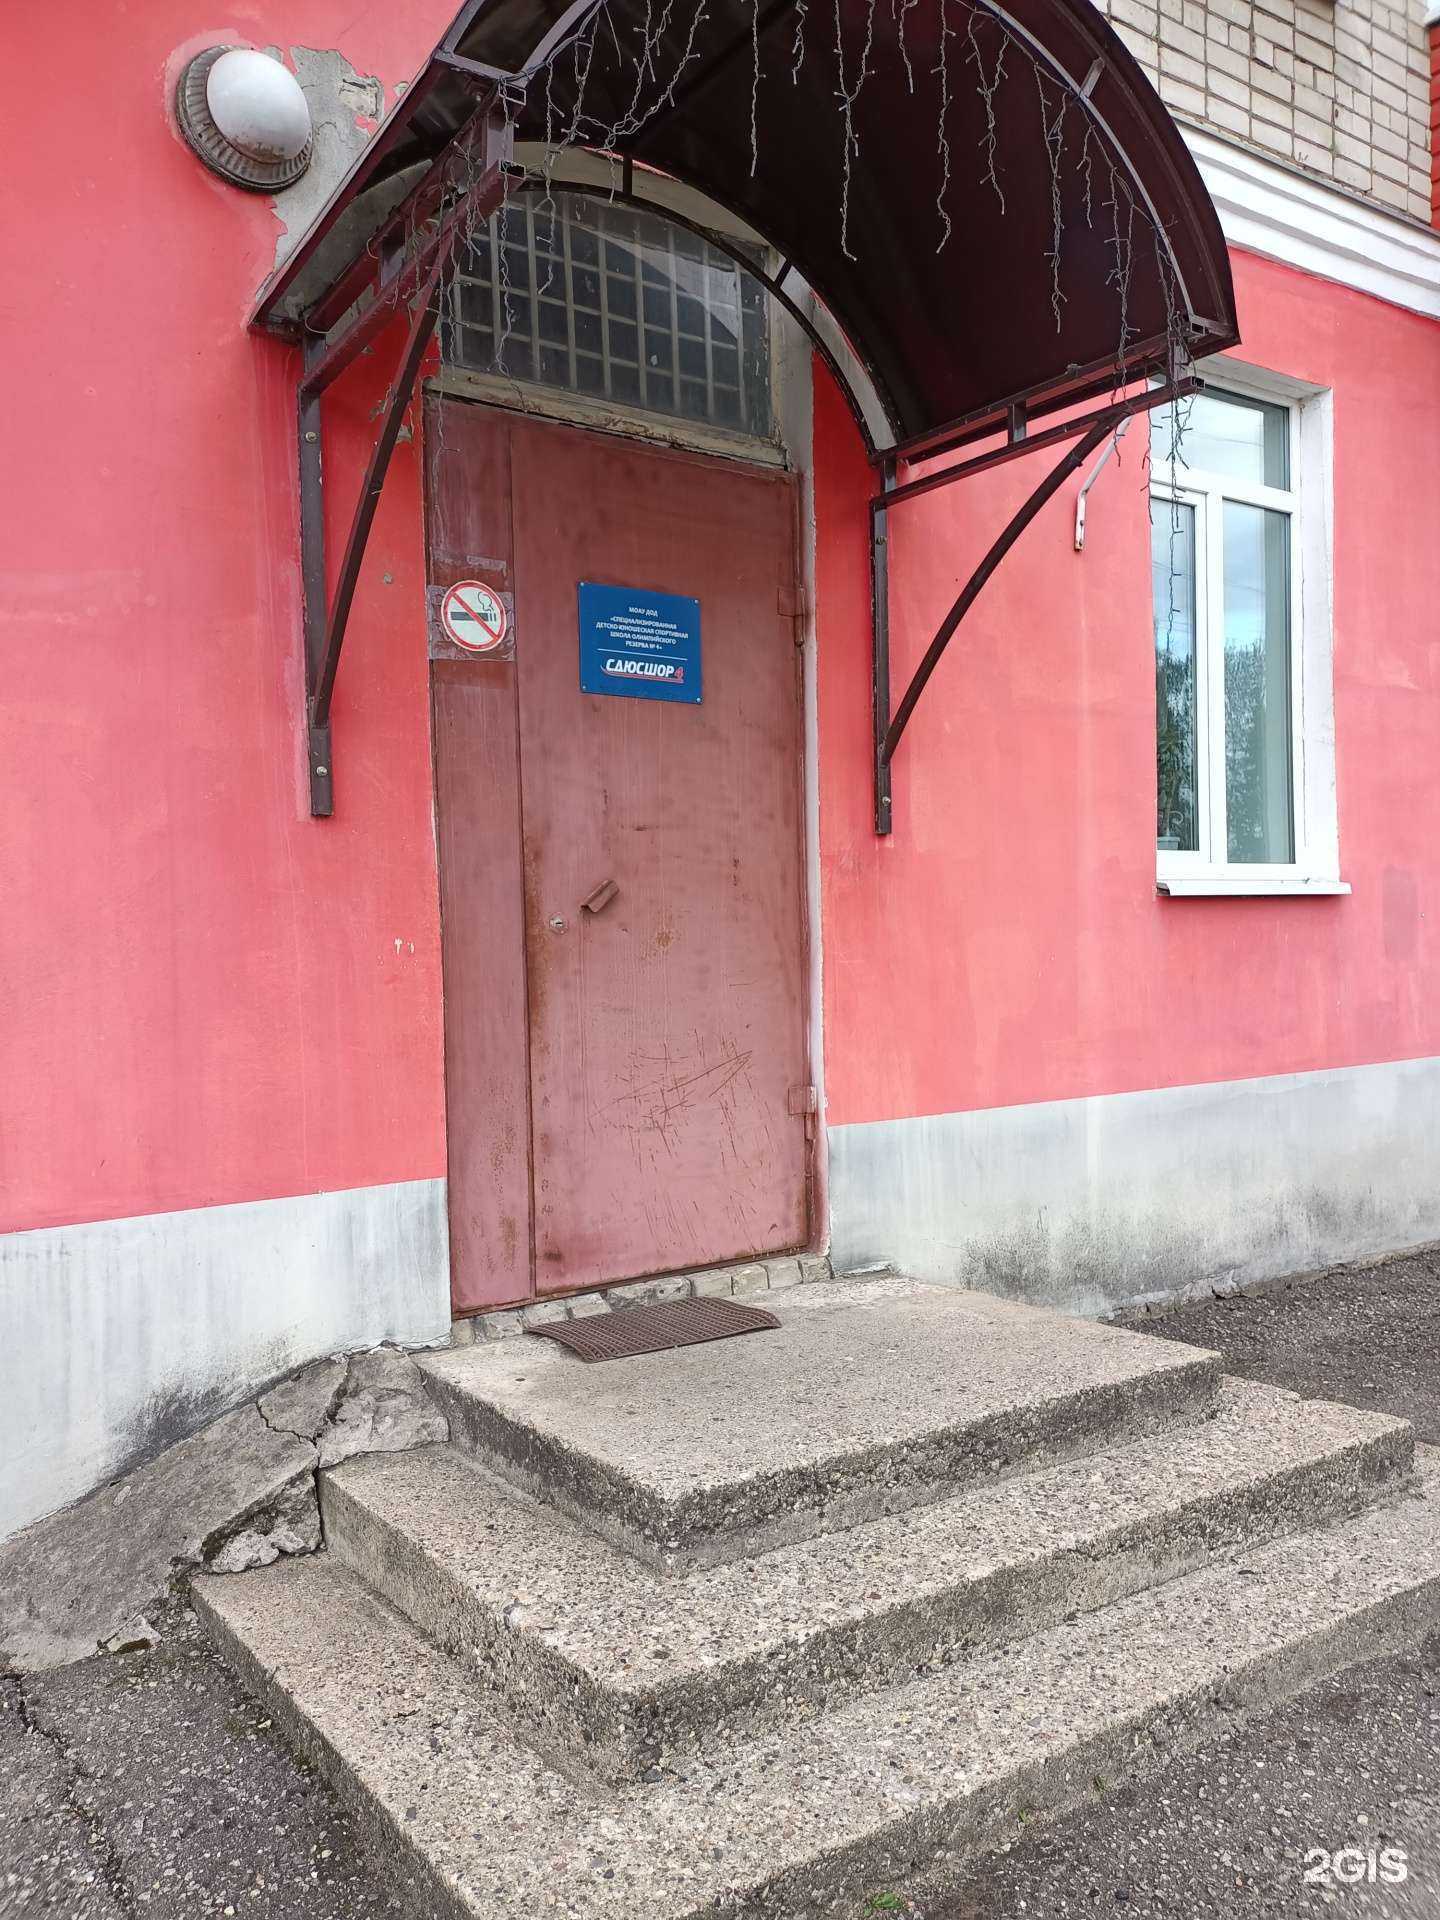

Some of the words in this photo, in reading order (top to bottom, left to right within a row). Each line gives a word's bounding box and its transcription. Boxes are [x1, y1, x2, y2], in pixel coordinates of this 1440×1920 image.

[610, 631, 631, 639] ШКОЛА
[631, 633, 676, 644] ОЛИМПИЙСКОГО
[655, 629, 688, 639] СПОРТИВНАЯ
[625, 641, 649, 649] РЕЗЕРВА
